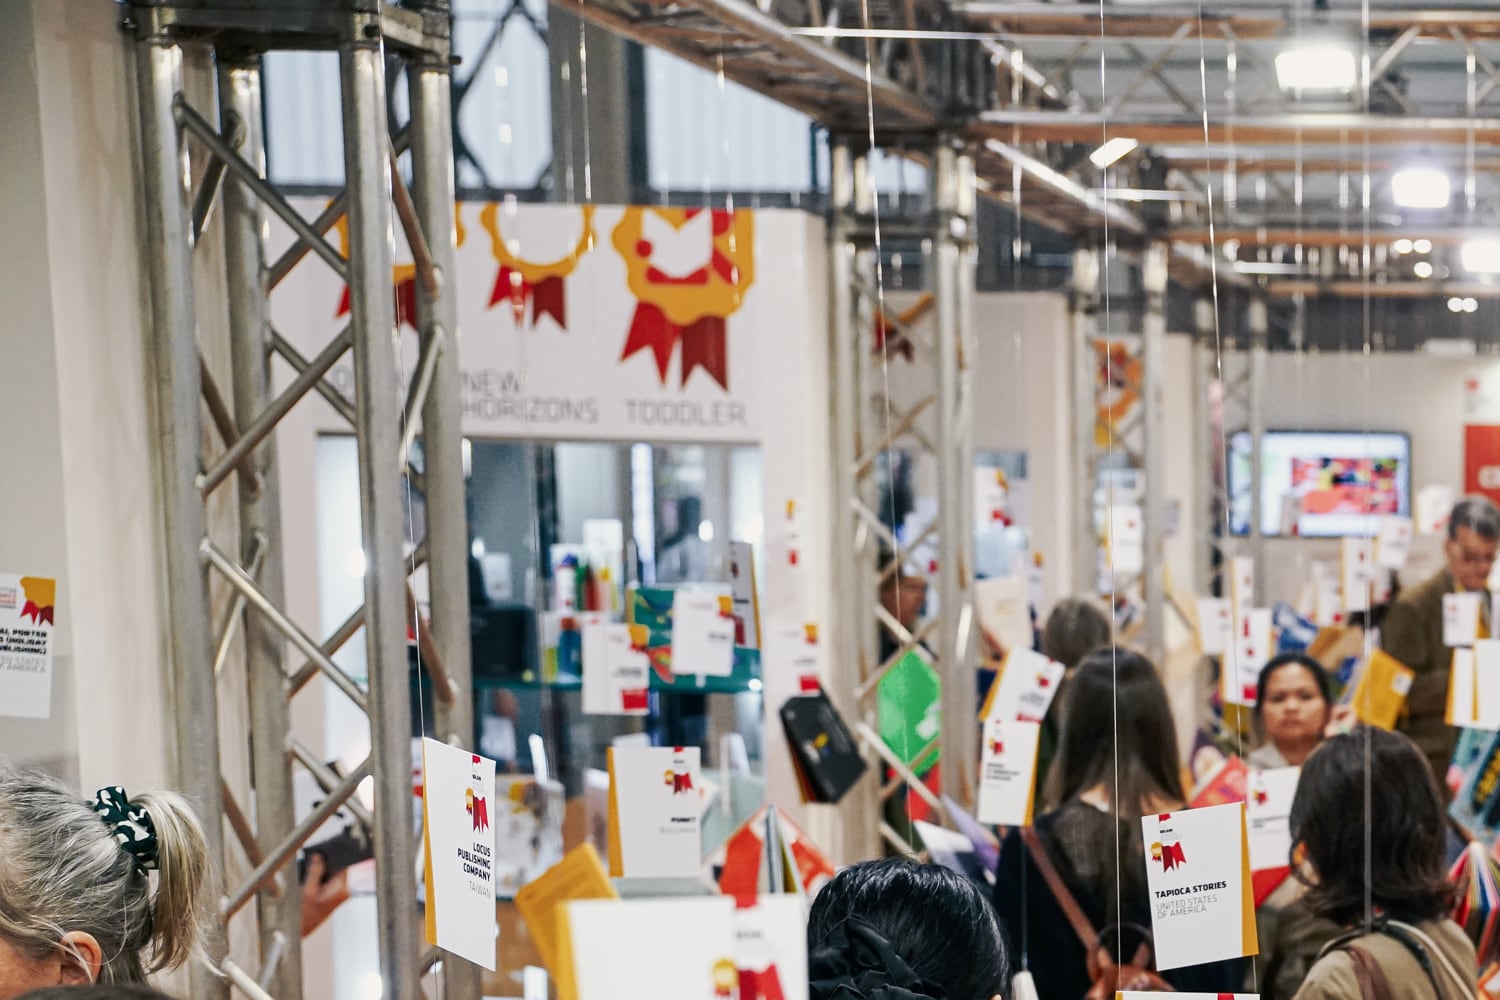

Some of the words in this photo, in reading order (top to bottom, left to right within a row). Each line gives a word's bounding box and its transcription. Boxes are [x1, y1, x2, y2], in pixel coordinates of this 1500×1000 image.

[460, 370, 521, 393] NEW
[460, 399, 600, 424] HORIZONS
[623, 400, 746, 426] TODDLER
[457, 847, 491, 870] PUBLISHING
[473, 842, 491, 857] LOCUS
[463, 862, 491, 882] COMPANY
[469, 880, 491, 899] TAIWAN
[1155, 886, 1191, 899] TAPIOCA
[1193, 880, 1227, 893] STORIES
[1156, 898, 1186, 911] UNITED
[1188, 894, 1218, 906] STATES
[1157, 910, 1167, 919] OF
[1170, 904, 1207, 917] AMERICA
